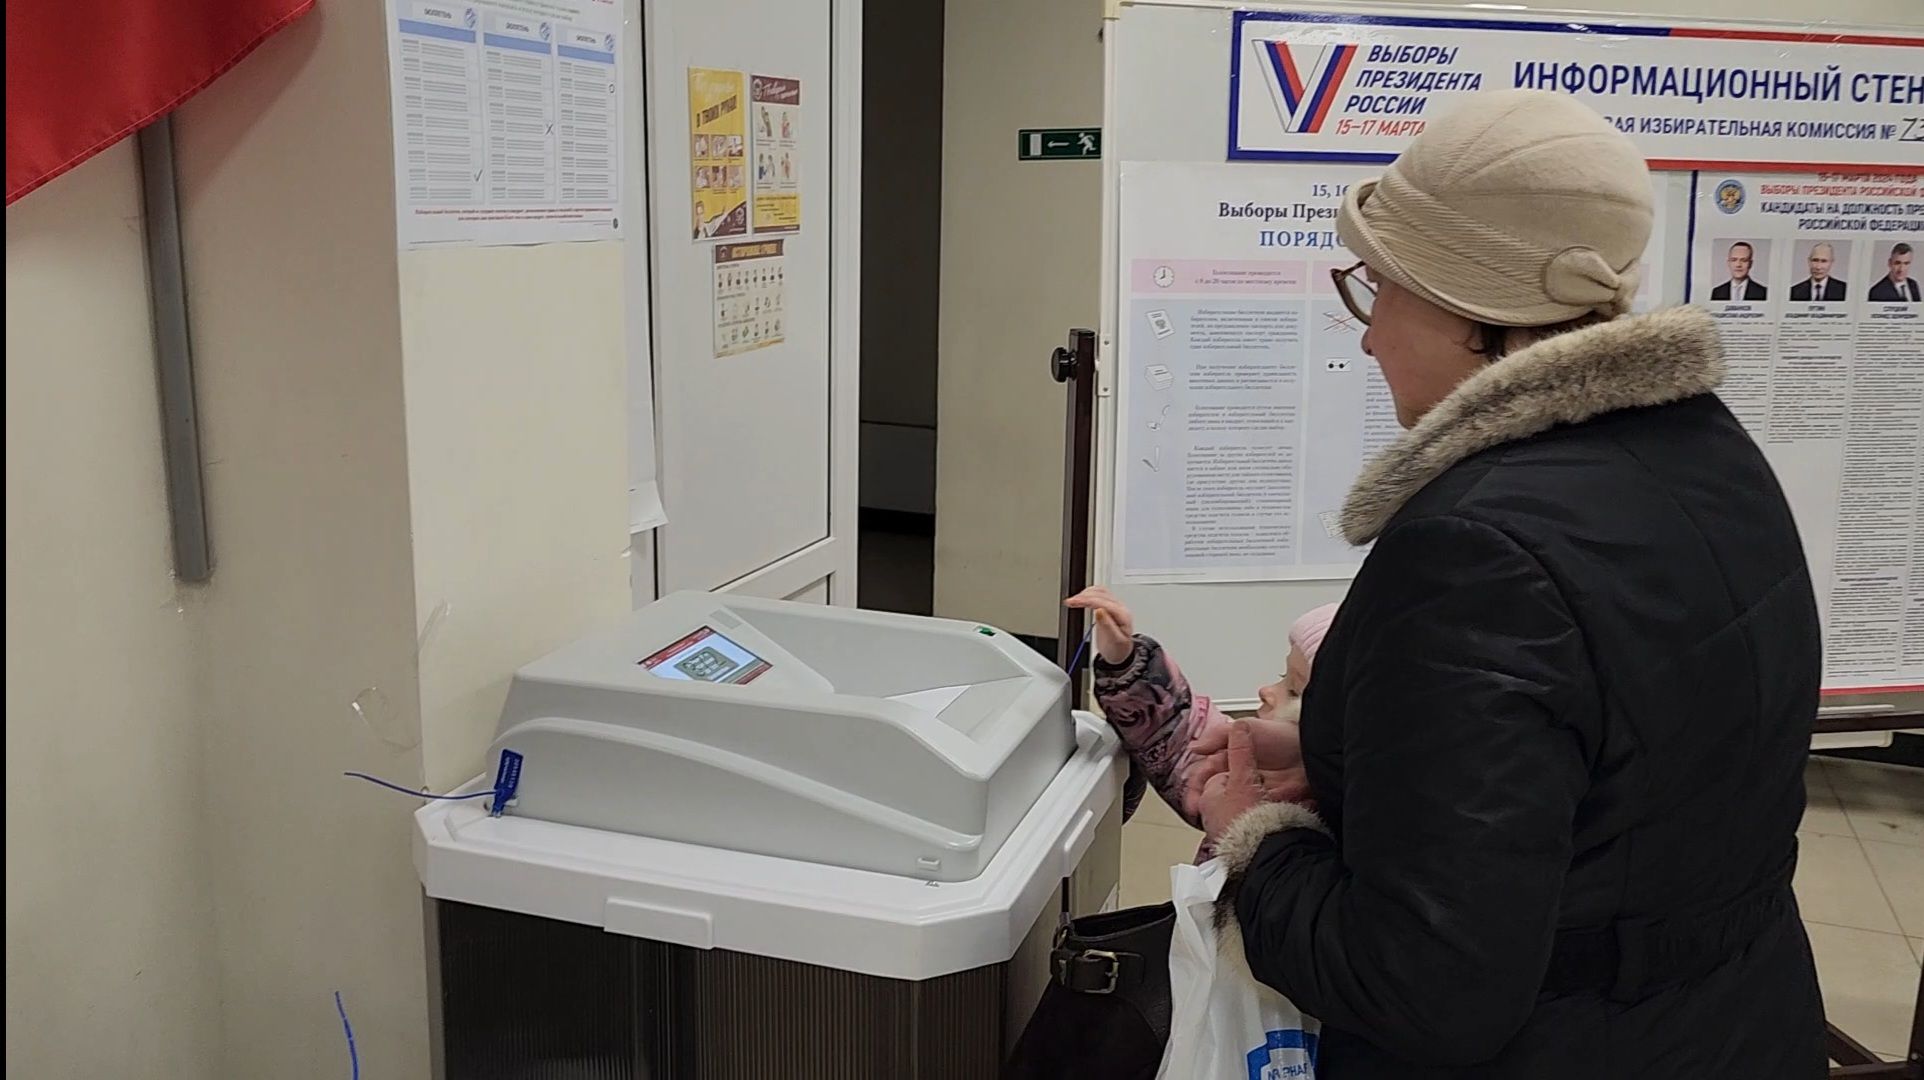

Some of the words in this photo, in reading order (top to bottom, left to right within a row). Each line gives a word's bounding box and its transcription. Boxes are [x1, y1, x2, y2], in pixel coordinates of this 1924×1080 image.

[1367, 45, 1458, 65] ВЫБОРЫ
[1355, 70, 1482, 92] ПРЕЗИДЕНТА
[1513, 61, 1841, 104] ИНФОРМАЦИОННЫЙ
[1852, 73, 1924, 105] СТЕН
[1344, 95, 1427, 114] РОССИИ
[1376, 120, 1426, 136] МАРТА
[1604, 116, 1635, 133] АЯ
[1640, 117, 1782, 137] ИЗБИРАТЕЛЬНАЯ
[1787, 121, 1876, 140] КОМИССИЯ
[1880, 124, 1897, 140] №
[1312, 184, 1331, 198] 15,
[1218, 201, 1288, 222] Выборы
[1760, 201, 1824, 214] КАНДИДАТЫ
[1827, 202, 1840, 213] НА
[1841, 203, 1904, 215] ДОЛЖНОСТЬ
[1798, 217, 1867, 231] РОССИЙСКОЙ
